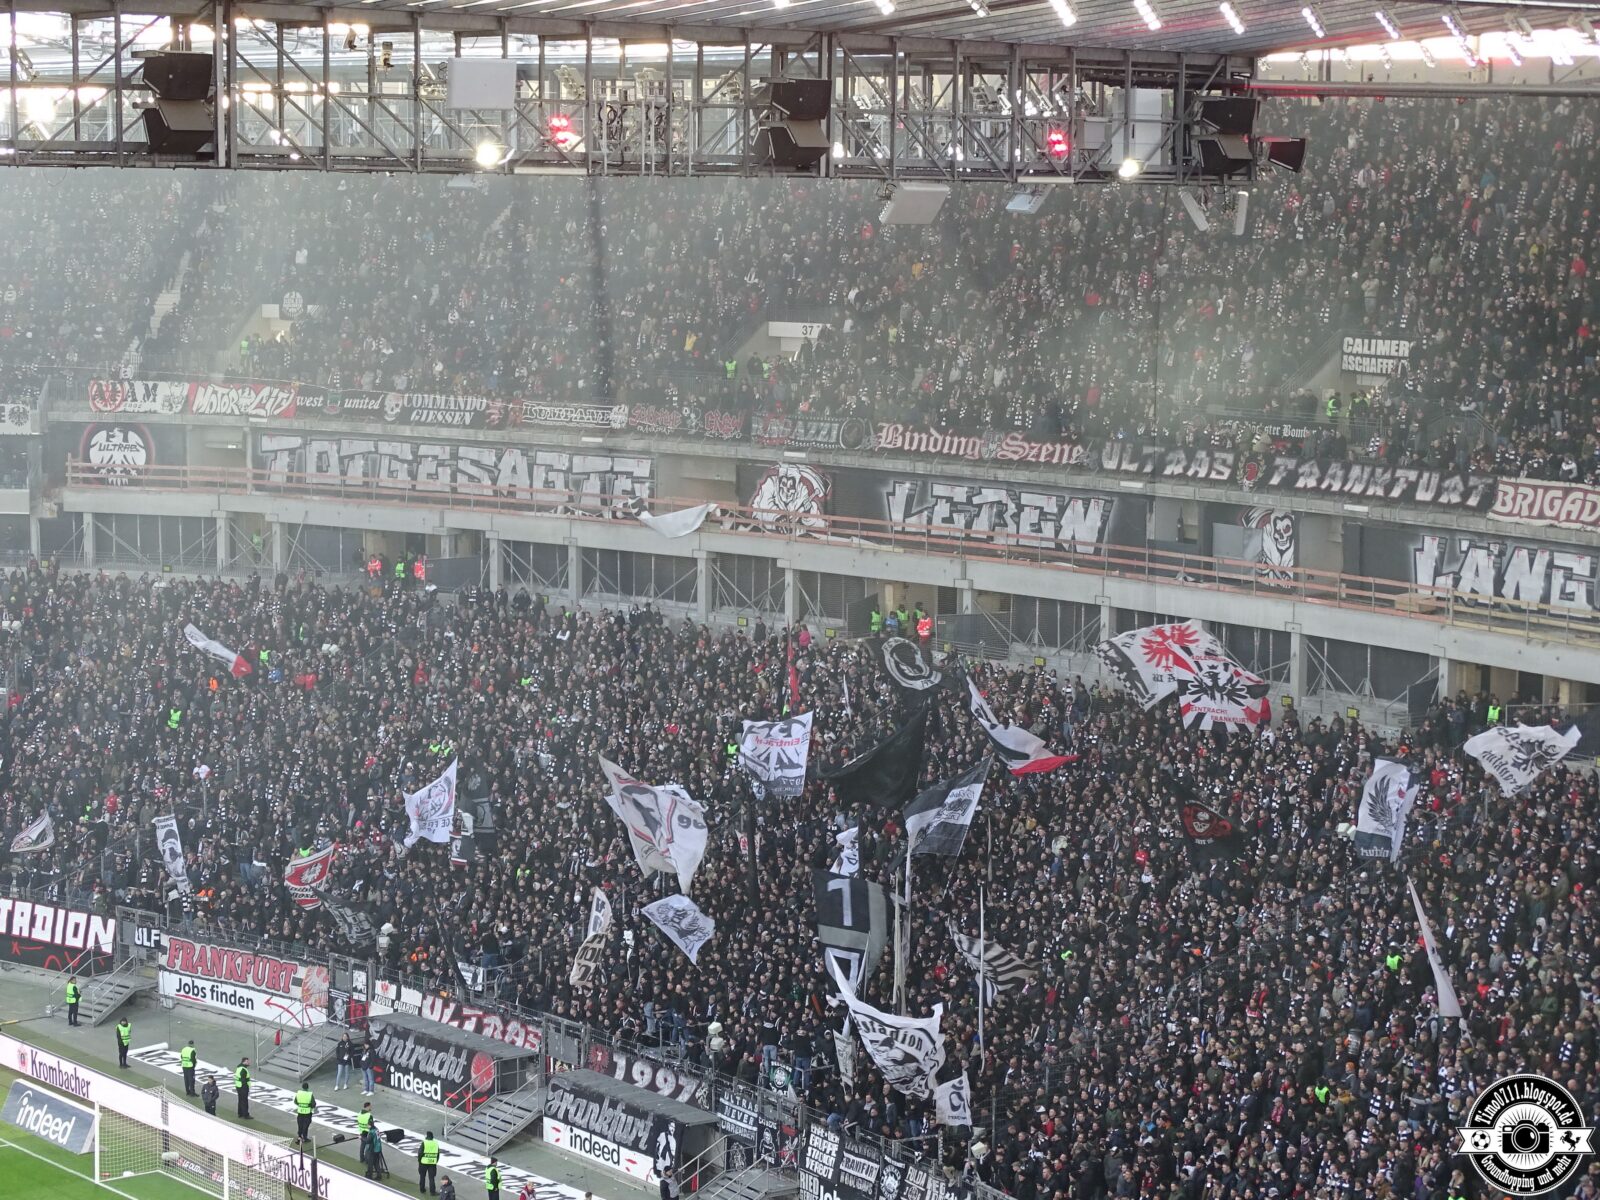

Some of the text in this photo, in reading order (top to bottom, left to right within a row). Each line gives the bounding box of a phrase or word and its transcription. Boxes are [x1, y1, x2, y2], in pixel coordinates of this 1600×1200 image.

[802, 325, 814, 336] 37
[192, 384, 239, 417] MOTOR
[296, 393, 384, 410] west united
[403, 392, 487, 411] COMMANDO
[411, 409, 474, 426] GIESSEN
[874, 423, 1084, 466] Binding Szene
[260, 433, 652, 510] TOTGESAGTE
[1101, 443, 1496, 508] ULTRAS FRANKFURT
[886, 480, 1106, 555] LEBEN
[135, 925, 160, 947] ULF
[167, 938, 298, 994] FRANKFURT
[176, 977, 254, 1011] Jobs finden
[421, 994, 543, 1052] ULTRAS
[30, 1048, 91, 1100] Krombacher
[390, 1065, 441, 1101] indeed
[612, 1051, 701, 1105] 1997
[15, 1090, 76, 1146] indeed
[723, 1105, 755, 1126] NEVER
[724, 1090, 759, 1113] ULTRAS
[569, 1127, 621, 1167] indeed
[258, 1141, 331, 1199] Krombacer
[800, 1171, 820, 1196] RIED
